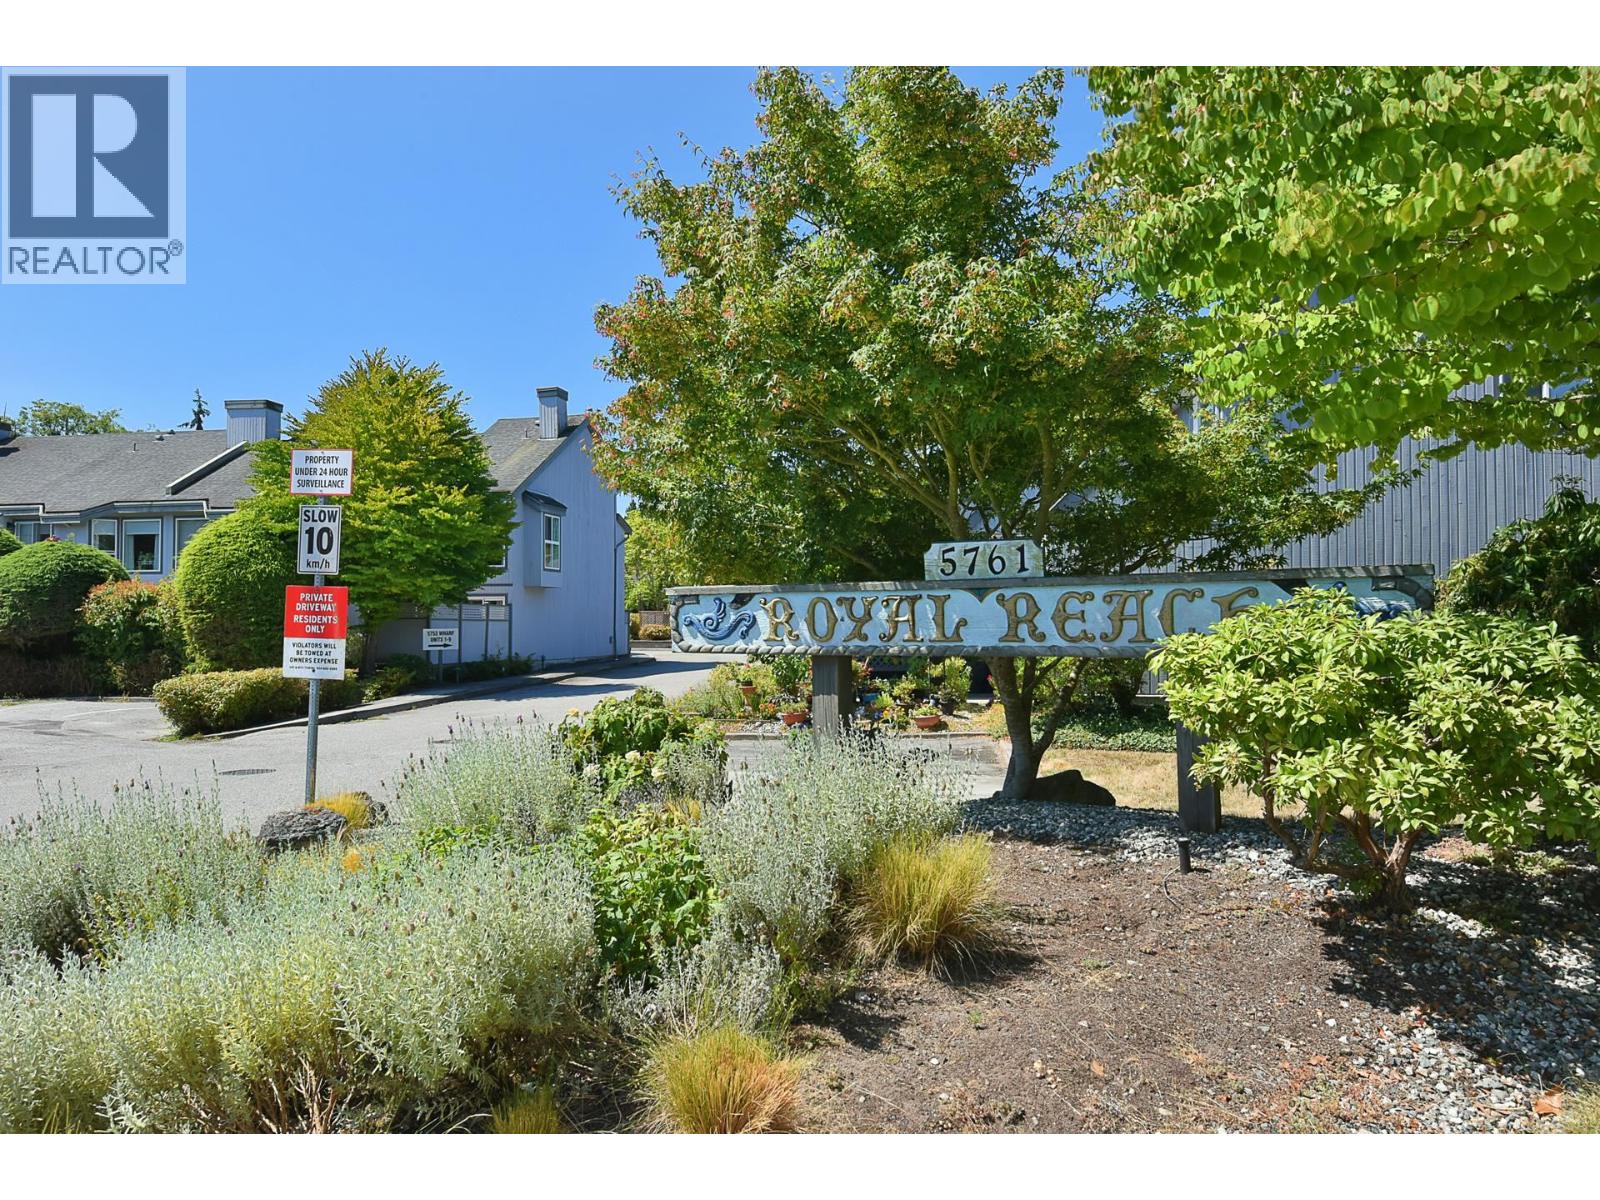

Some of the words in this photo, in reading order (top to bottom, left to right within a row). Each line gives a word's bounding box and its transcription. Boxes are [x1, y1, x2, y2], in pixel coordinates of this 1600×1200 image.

[305, 456, 339, 464] PROPERTY
[295, 467, 318, 476] UNDER
[319, 468, 327, 476] 24
[329, 467, 348, 476] HOUR
[297, 480, 344, 488] SURVEILLANCE
[303, 510, 338, 523] SLOW
[305, 527, 333, 555] 10
[306, 559, 330, 569] km/h
[939, 546, 1029, 577] 5761
[300, 593, 333, 602] PRIVATE
[295, 603, 337, 612] DRIVEWAY
[293, 615, 338, 624] RESIDENTS
[759, 594, 968, 643] ROYAL
[305, 625, 325, 633] ONLY
